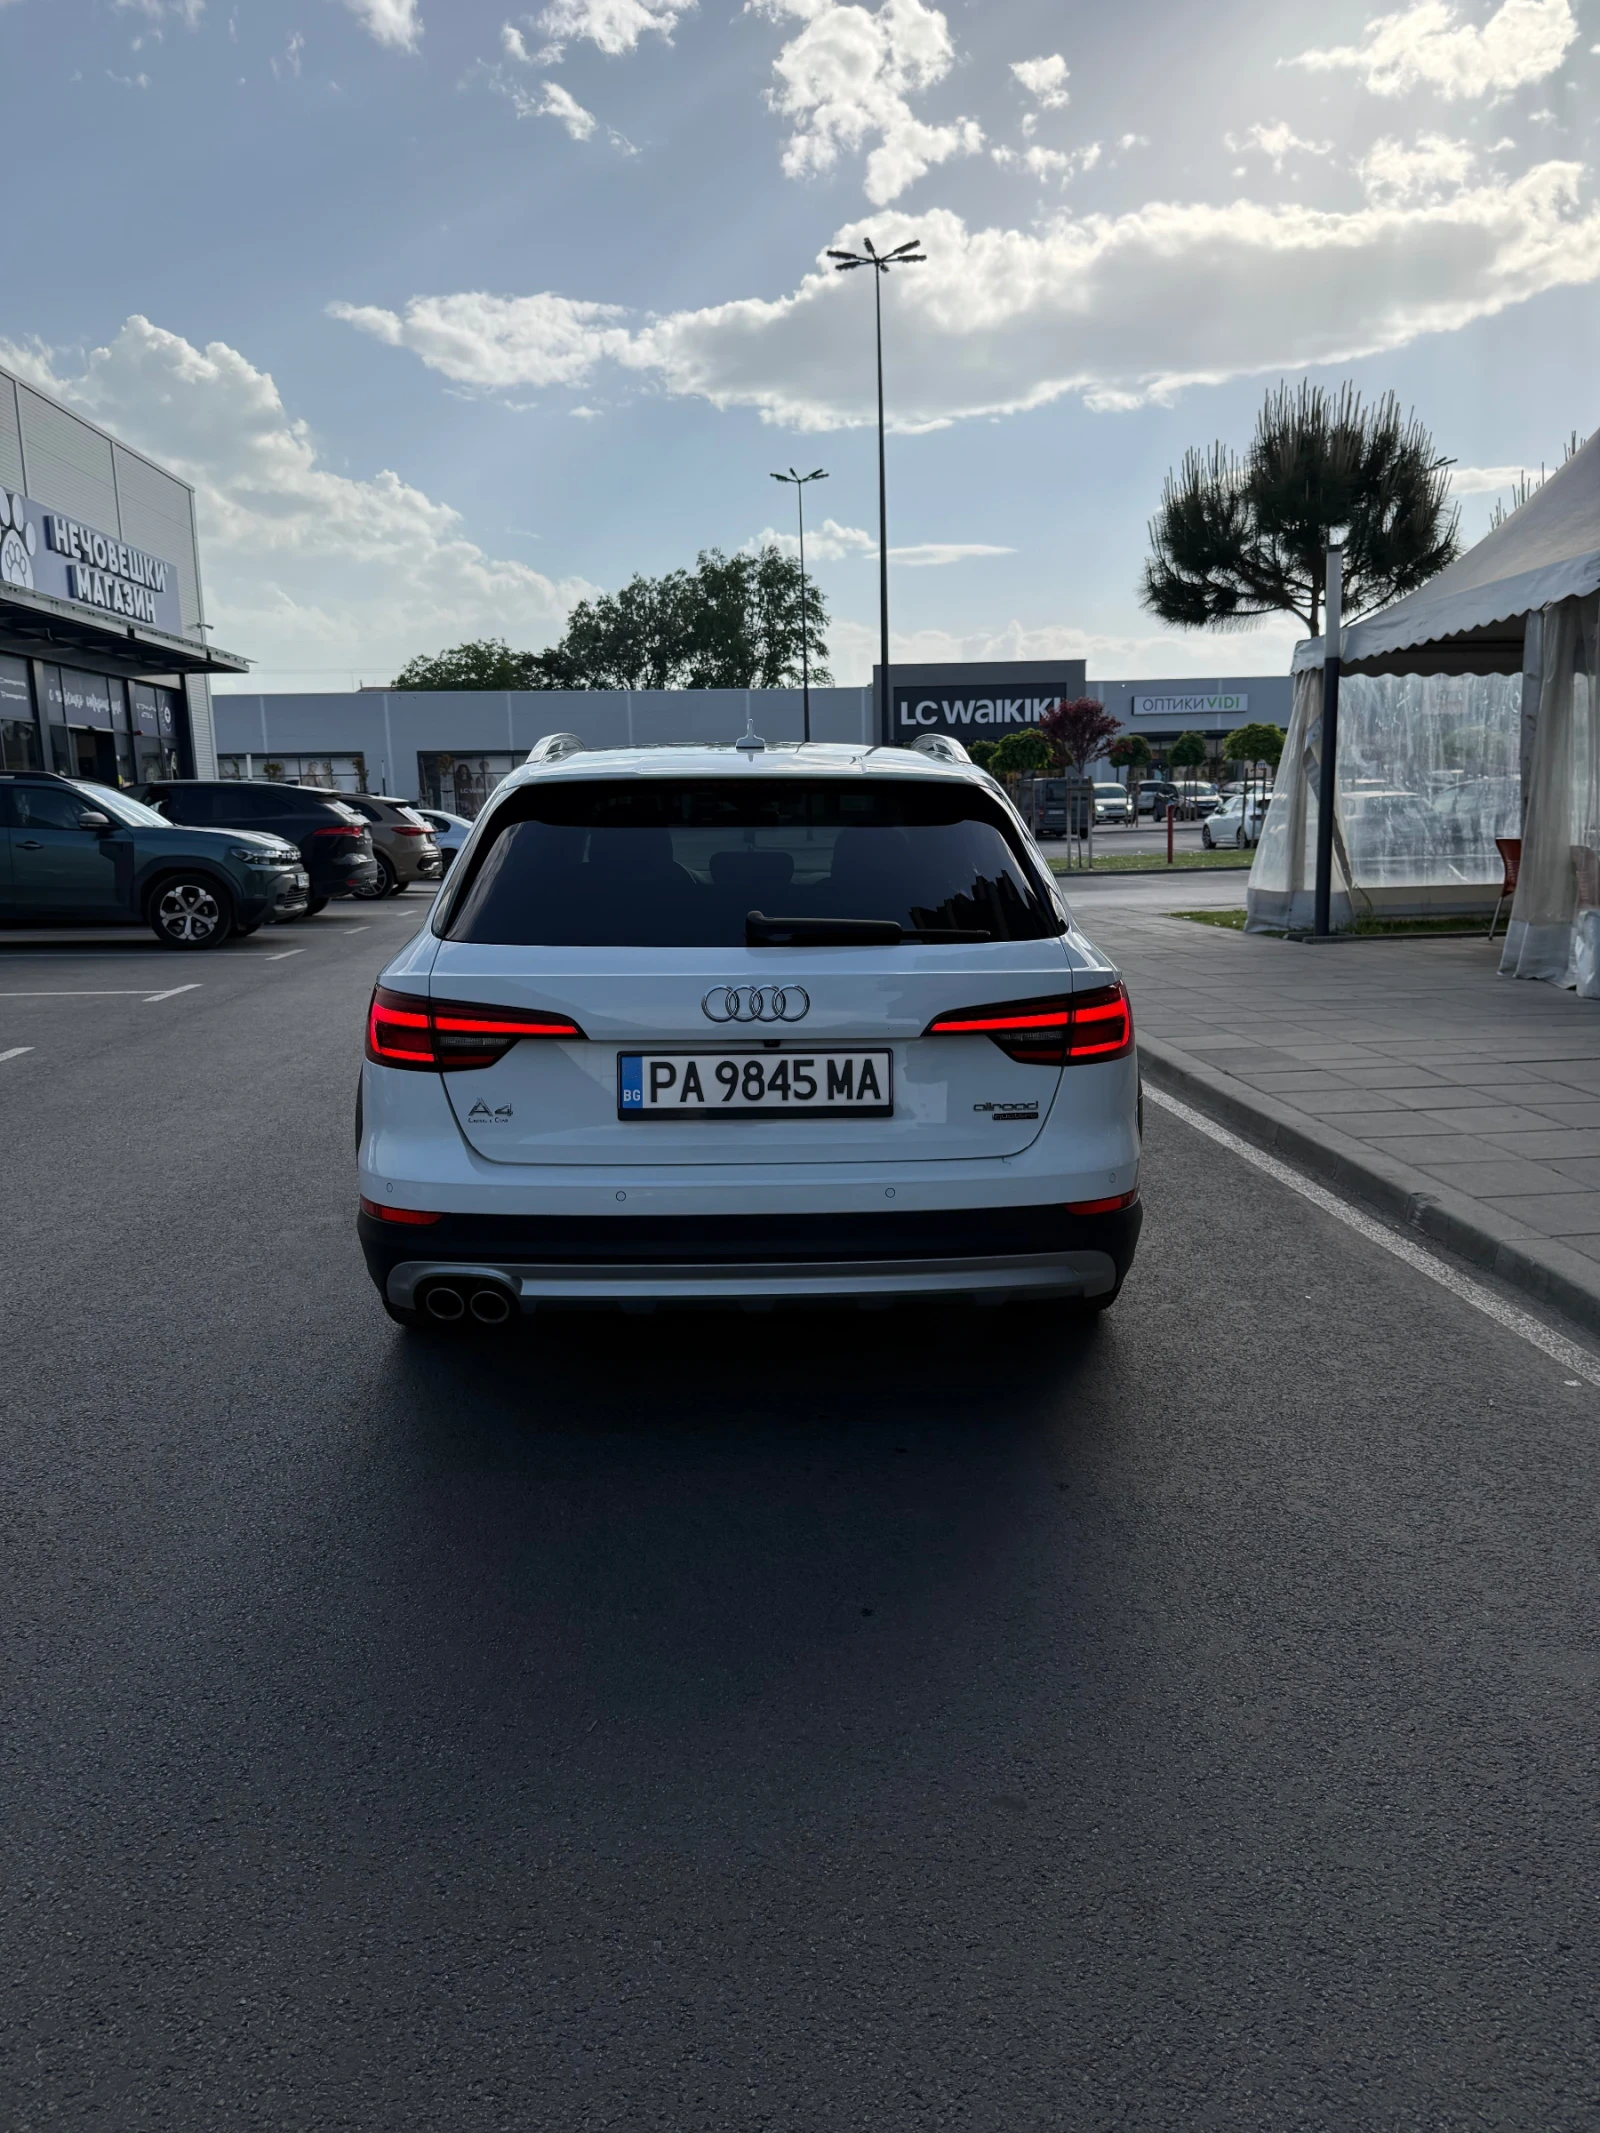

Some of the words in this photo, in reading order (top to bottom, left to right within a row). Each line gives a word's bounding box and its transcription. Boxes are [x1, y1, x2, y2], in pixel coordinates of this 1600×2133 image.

[52, 514, 167, 593] НЕЧОВЕШКИ
[75, 564, 157, 624] МАГАЗИН
[1142, 698, 1204, 712] ОПТИКИ
[1206, 696, 1240, 709] VIDI
[900, 700, 939, 726] LC
[650, 1061, 705, 1103] PA
[715, 1059, 818, 1102] 9845
[827, 1059, 882, 1100] MA
[623, 1089, 641, 1102] BG
[468, 1097, 514, 1117] A4
[973, 1101, 1039, 1112] allroad
[994, 1112, 1038, 1120] quattro
